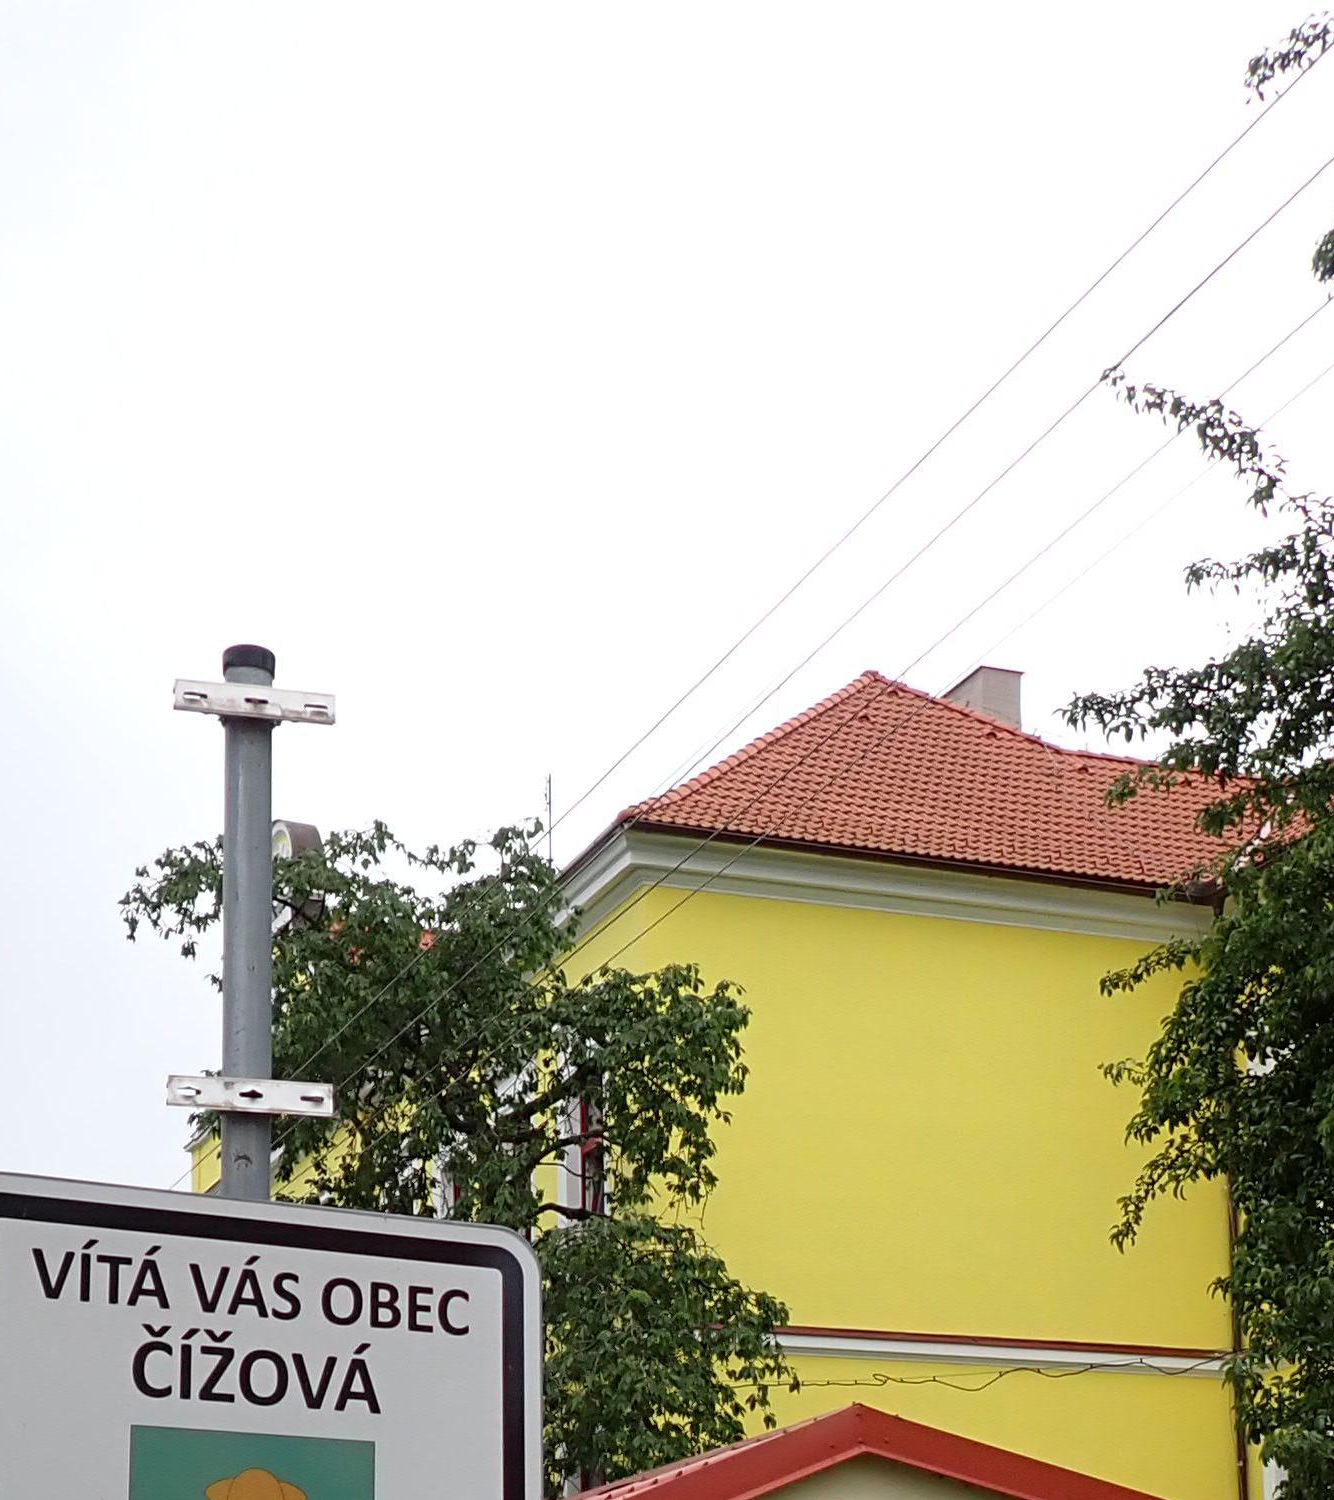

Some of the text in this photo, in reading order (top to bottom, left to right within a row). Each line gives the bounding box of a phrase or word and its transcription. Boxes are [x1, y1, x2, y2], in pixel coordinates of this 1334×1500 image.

[31, 1239, 471, 1336] VÍTÁ VÁS OBEC
[132, 1323, 382, 1415] ČÍŽOVÁ
